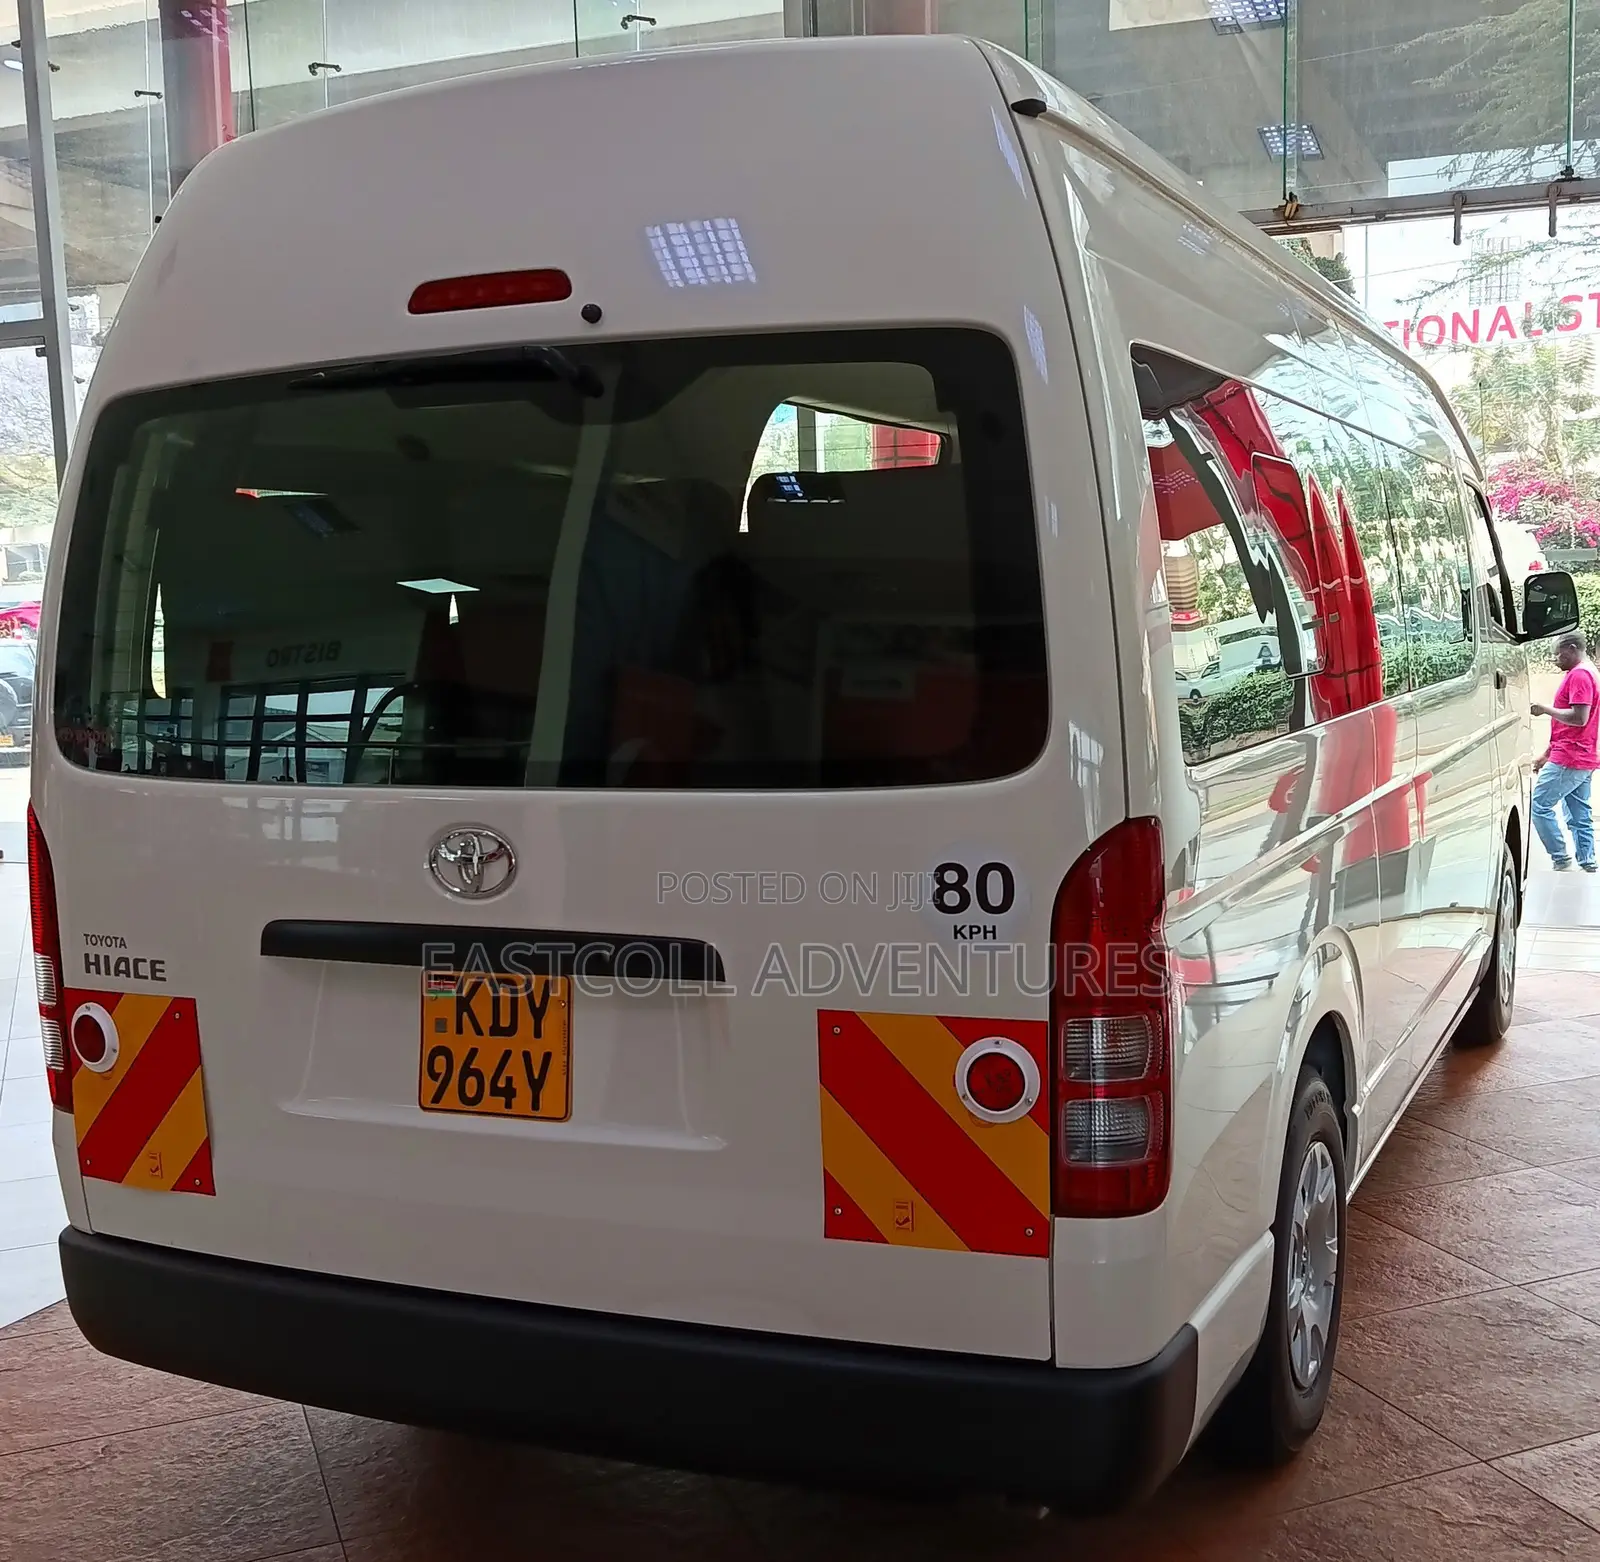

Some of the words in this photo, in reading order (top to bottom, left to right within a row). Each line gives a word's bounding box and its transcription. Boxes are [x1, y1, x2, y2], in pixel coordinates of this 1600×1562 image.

[932, 861, 1015, 915] 80
[83, 933, 127, 949] TOYOTA
[953, 924, 997, 940] KPH
[84, 953, 167, 982] HIACE
[455, 975, 551, 1039] KDY
[426, 1045, 552, 1112] 964Y
